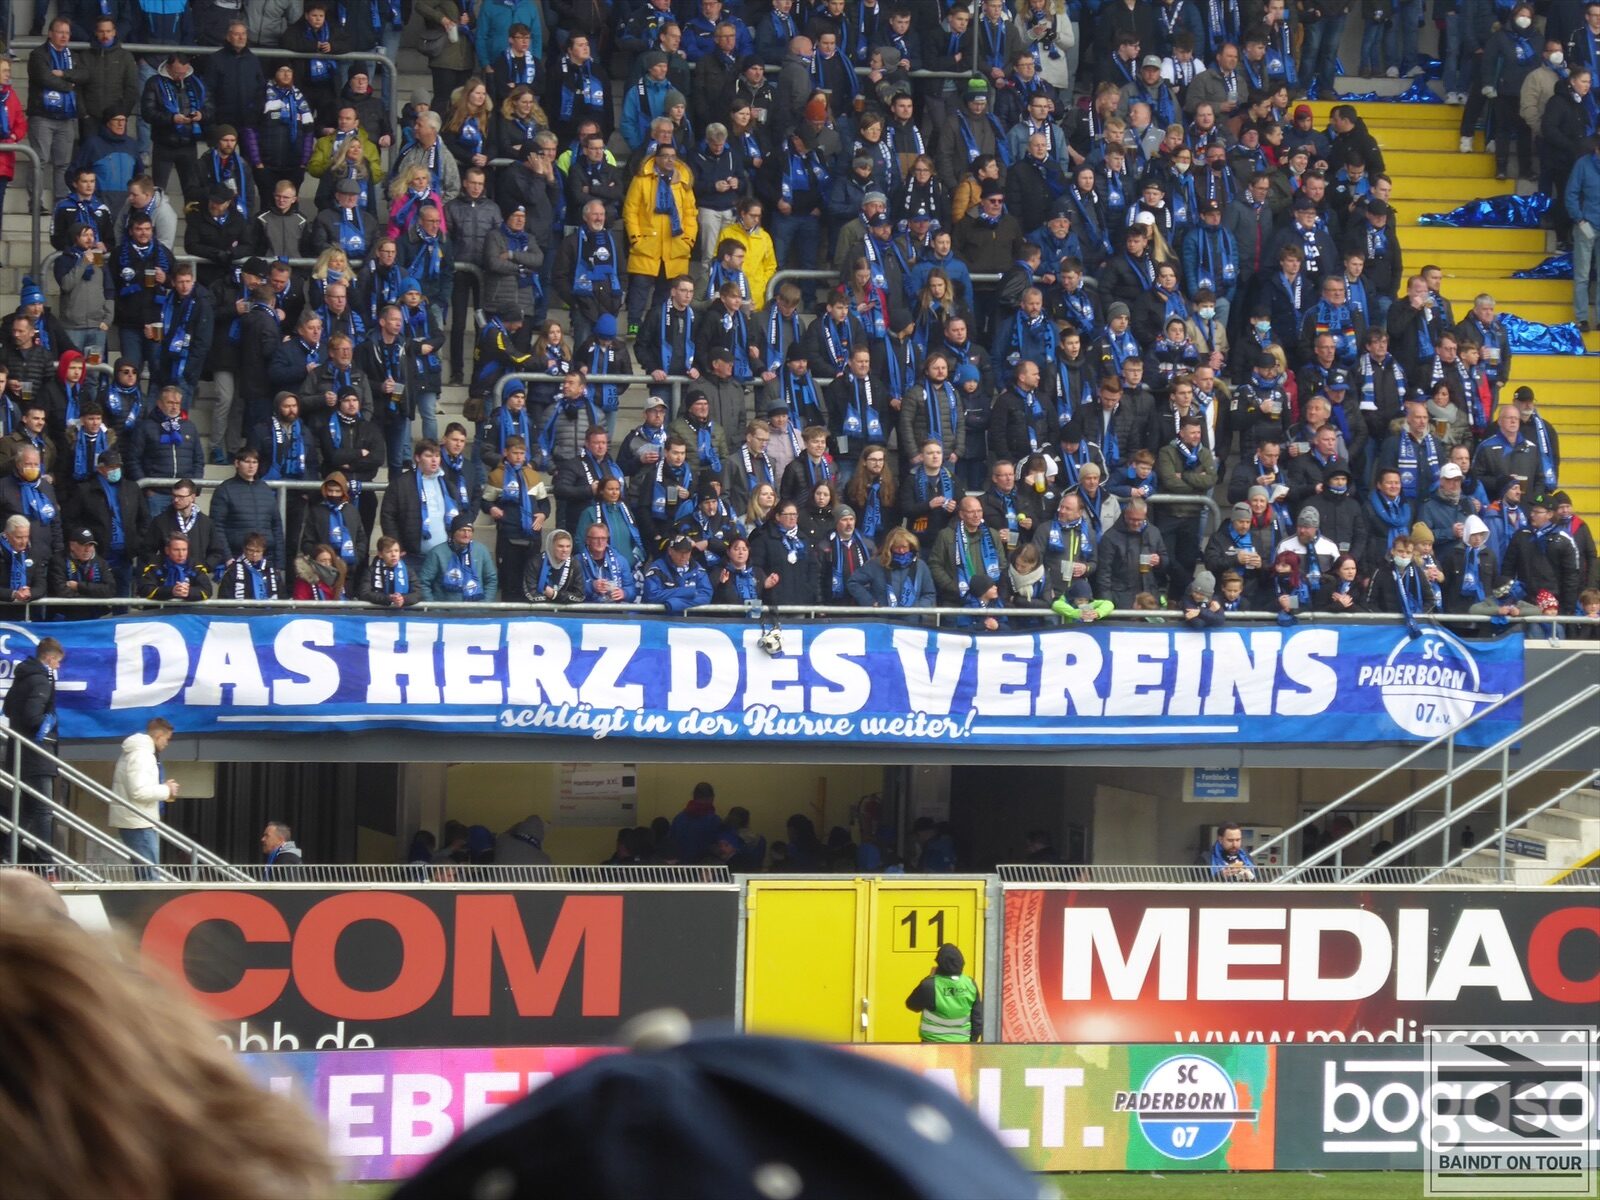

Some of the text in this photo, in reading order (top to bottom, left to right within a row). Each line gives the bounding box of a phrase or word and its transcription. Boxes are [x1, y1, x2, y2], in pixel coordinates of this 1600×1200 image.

[1422, 640, 1444, 661] SC
[110, 621, 1338, 716] DAS HERZ DES VEREINS
[1358, 665, 1466, 689] PADERBORN
[499, 702, 975, 739] schlägt in der Kurve weiter!
[1415, 703, 1436, 723] 07
[901, 909, 945, 948] 11
[68, 891, 624, 1020] COM
[1177, 1065, 1199, 1084] SC
[1114, 1092, 1226, 1111] PADERBORN
[1323, 1061, 1600, 1152] bogaso
[1171, 1126, 1200, 1148] 07
